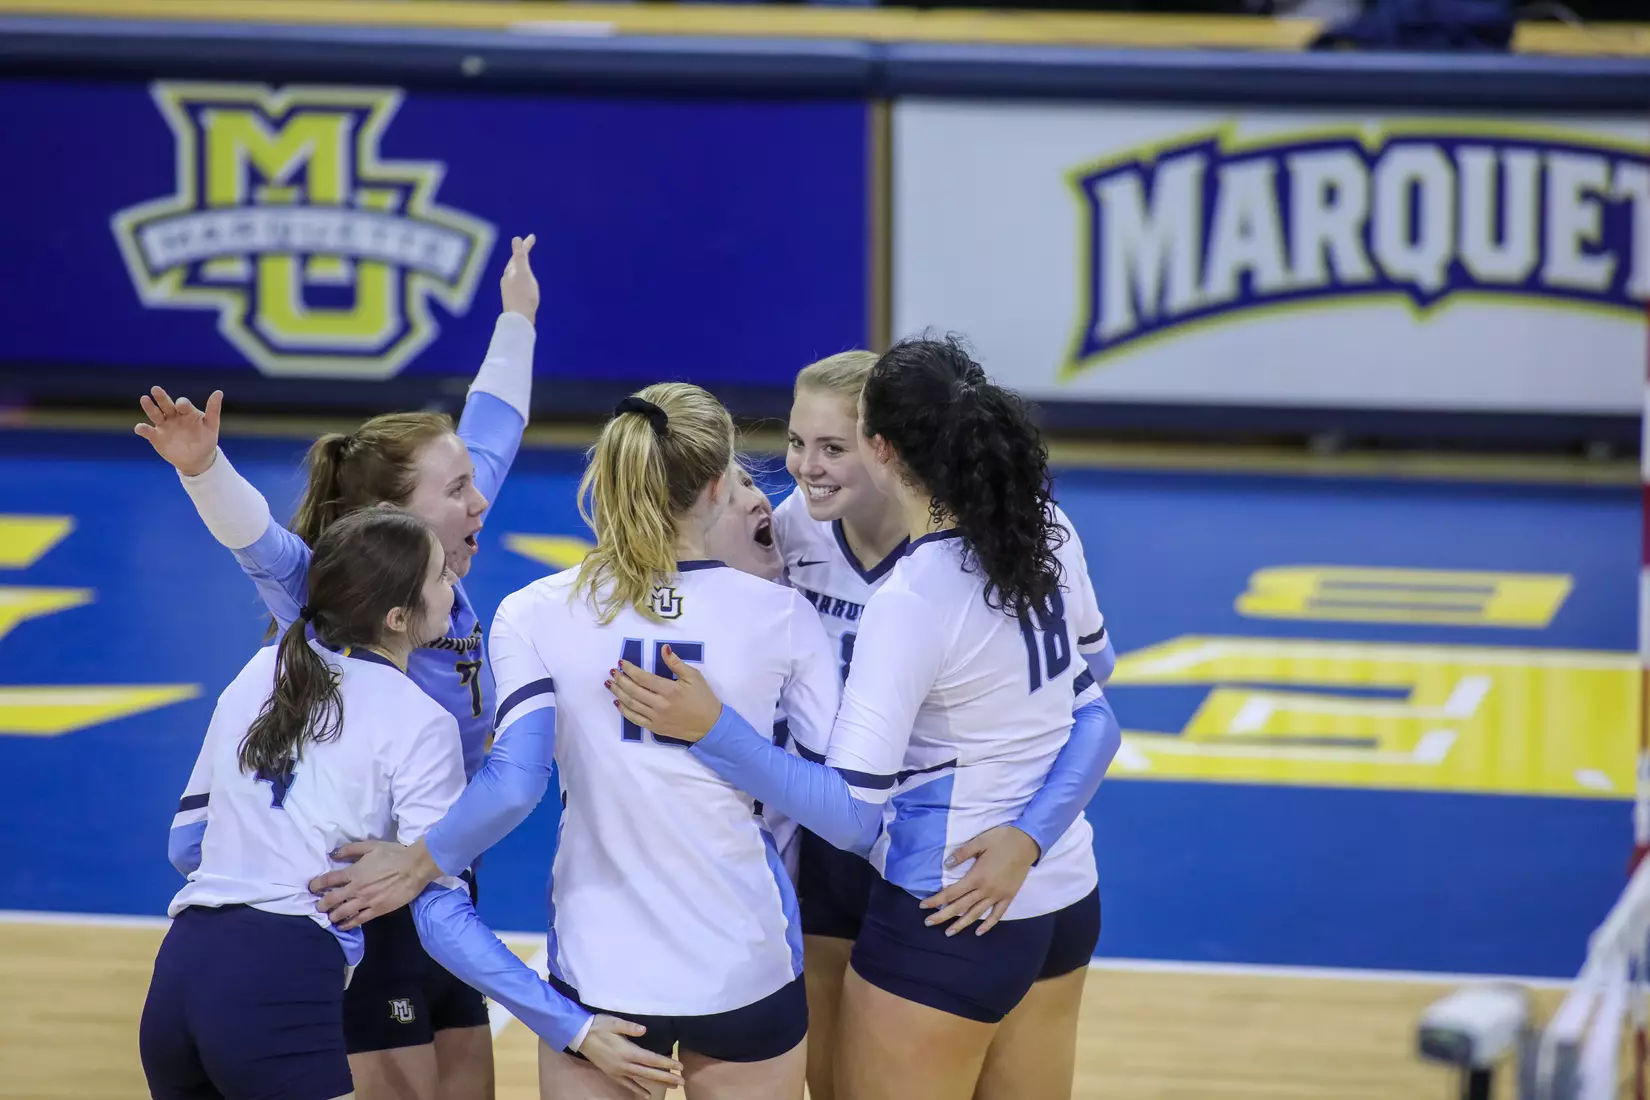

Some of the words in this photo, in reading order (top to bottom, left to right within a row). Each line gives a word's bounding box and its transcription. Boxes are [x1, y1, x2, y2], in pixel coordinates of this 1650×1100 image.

[1017, 586, 1072, 695] 18
[454, 659, 483, 718] 7
[389, 999, 415, 1023] MU
